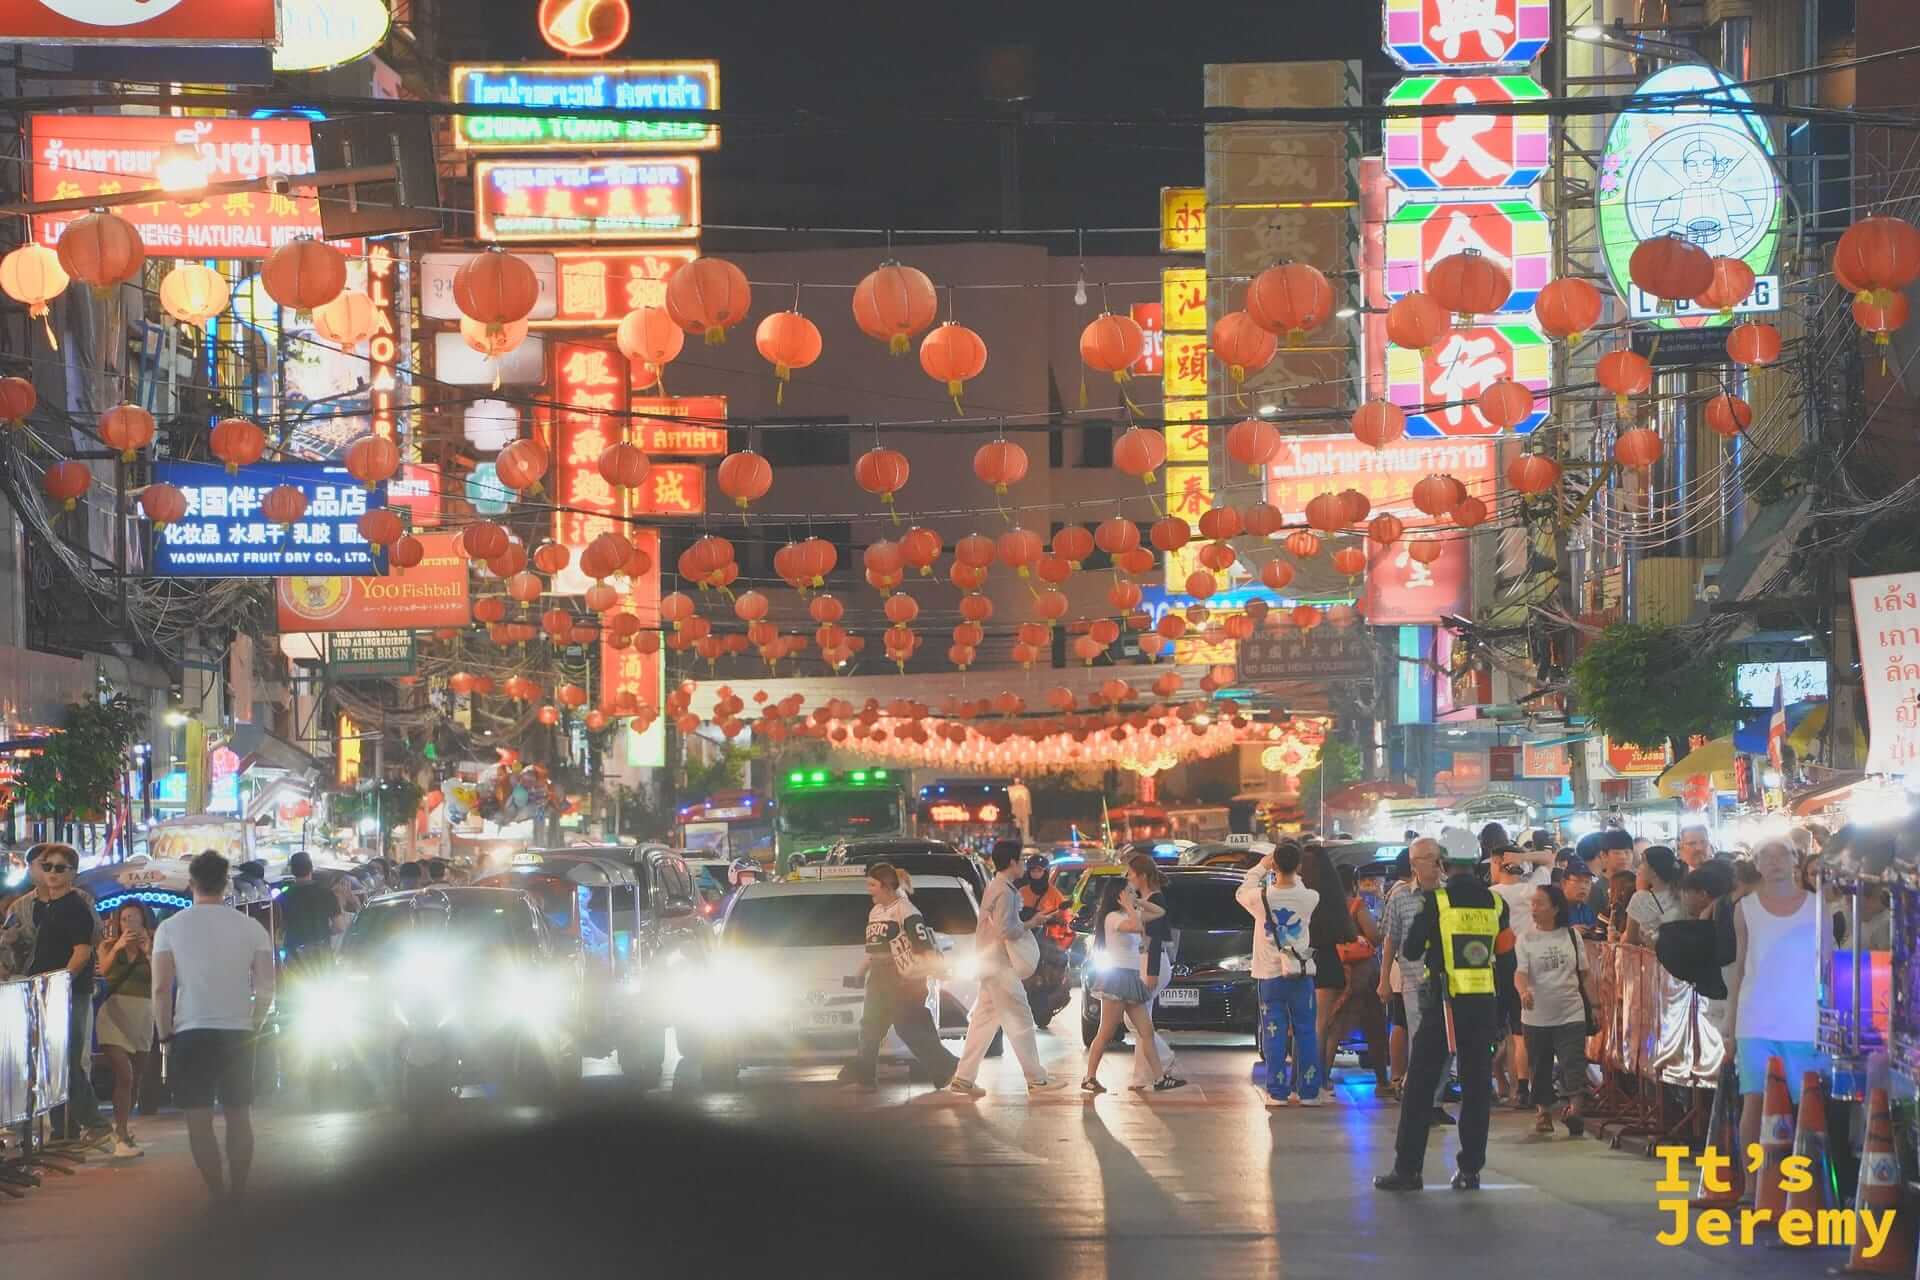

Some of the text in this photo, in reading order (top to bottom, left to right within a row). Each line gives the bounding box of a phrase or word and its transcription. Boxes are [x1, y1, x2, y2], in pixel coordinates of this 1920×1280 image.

[187, 224, 266, 247] NATURAL
[164, 523, 220, 545] 化妆品
[229, 523, 285, 545] 水果干
[293, 523, 331, 545] 乳胶
[169, 552, 371, 565] YAOWARAT FRUIT DRY CO., LTD.
[402, 582, 462, 598] Fishball
[363, 636, 412, 647] INGREDIENTS
[337, 648, 349, 661] IN
[352, 648, 375, 660] THE
[1231, 835, 1248, 843] TAXI
[128, 871, 154, 880] TAXI
